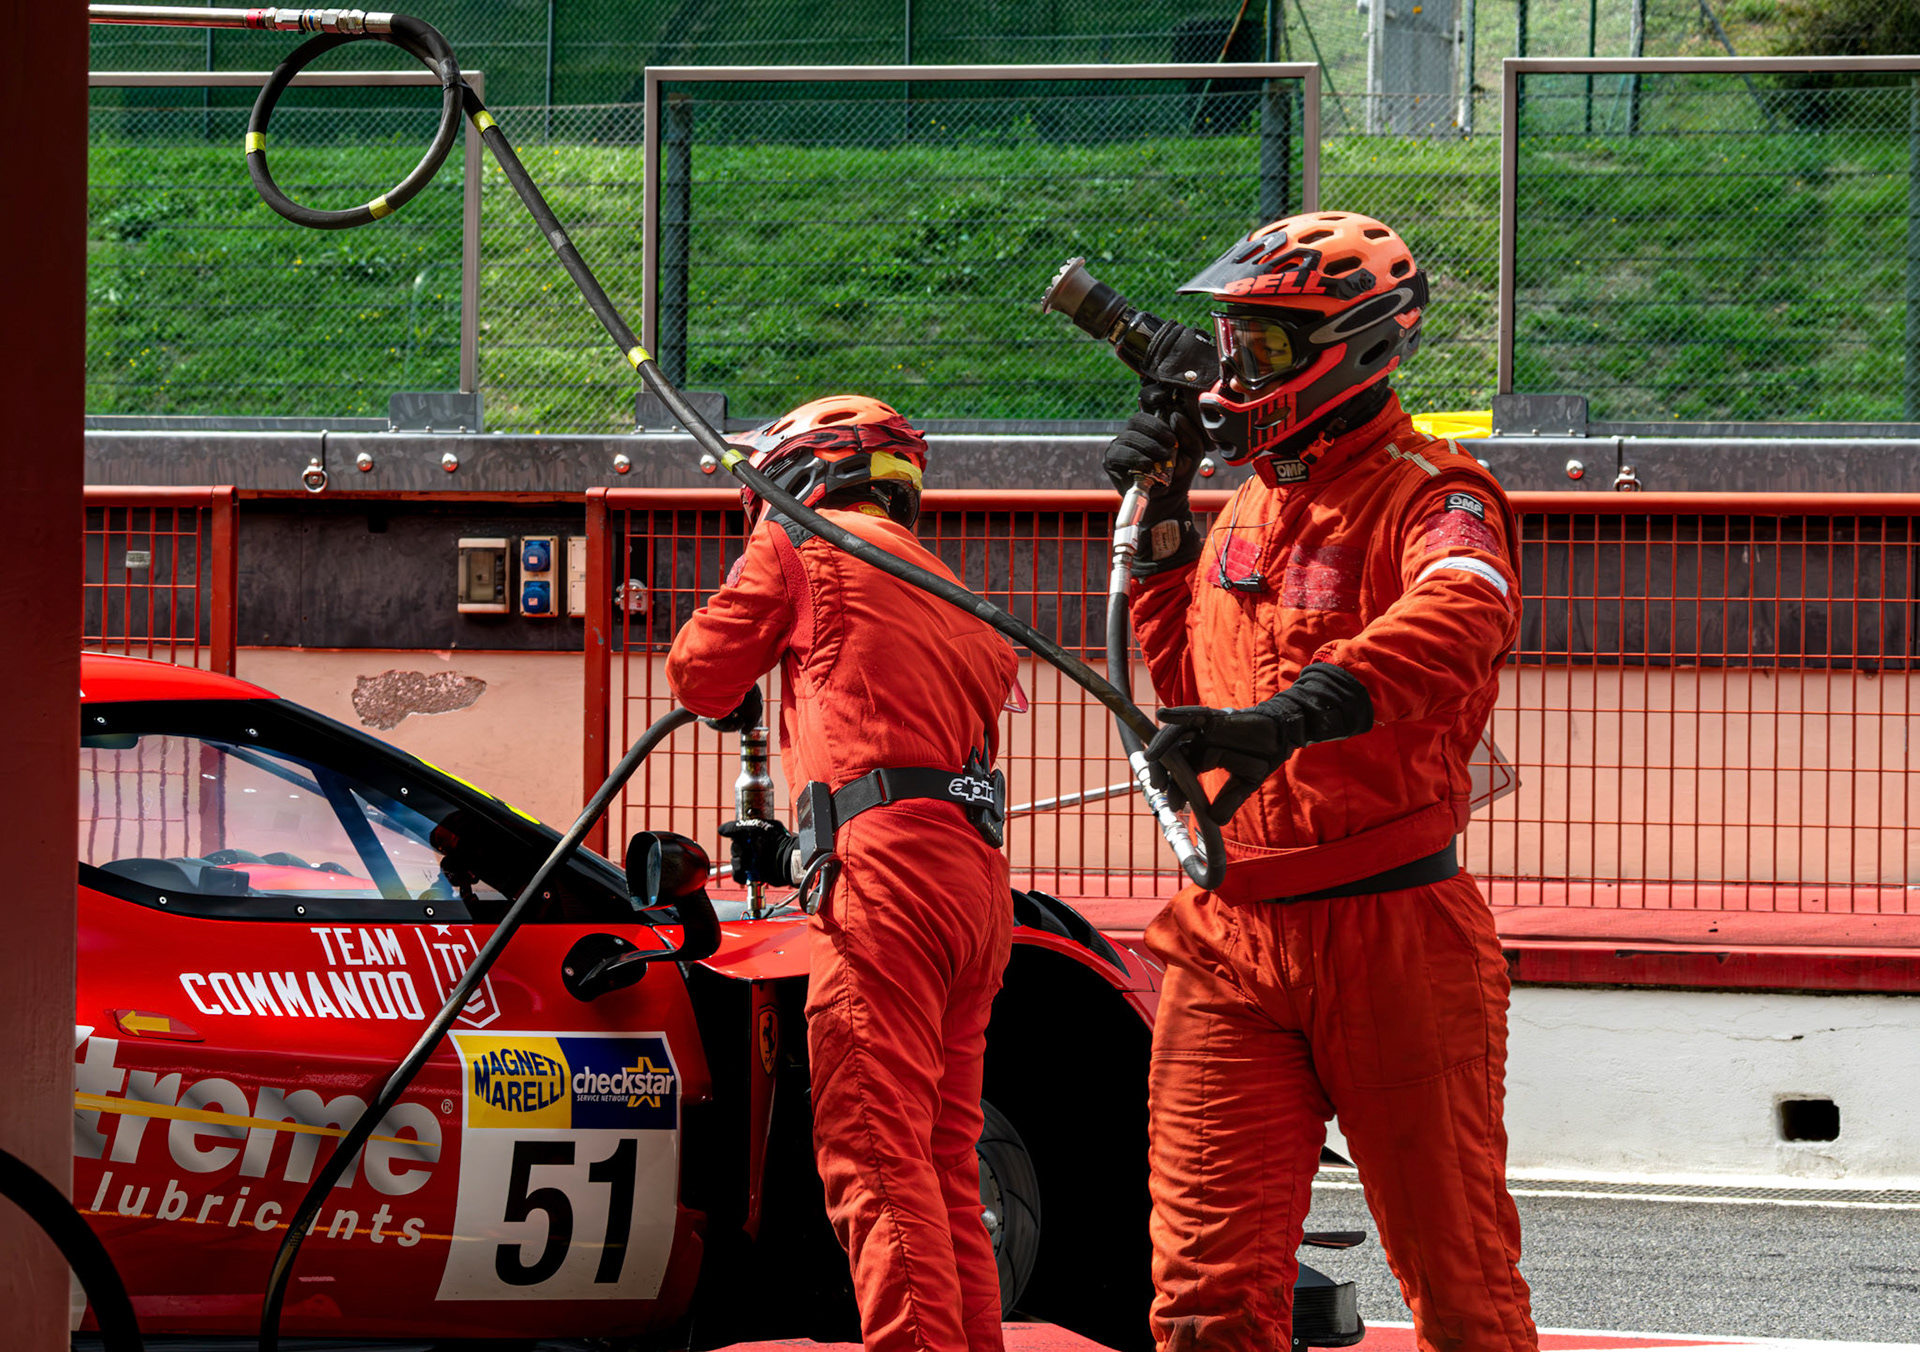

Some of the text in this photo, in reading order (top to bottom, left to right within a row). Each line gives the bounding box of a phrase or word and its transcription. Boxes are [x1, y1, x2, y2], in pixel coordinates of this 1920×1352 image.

[1223, 269, 1327, 296] BELL
[1276, 462, 1307, 478] OMP
[1449, 495, 1483, 512] OMP
[310, 926, 407, 966] TEAM
[179, 971, 426, 1020] COMMANDO
[473, 1048, 565, 1086] MAGNETI
[572, 1066, 675, 1096] checkstar
[74, 1025, 443, 1197] treme
[473, 1074, 565, 1113] MARELLI
[576, 1094, 629, 1103] SERVICE NETWORK
[494, 1137, 639, 1287] 51
